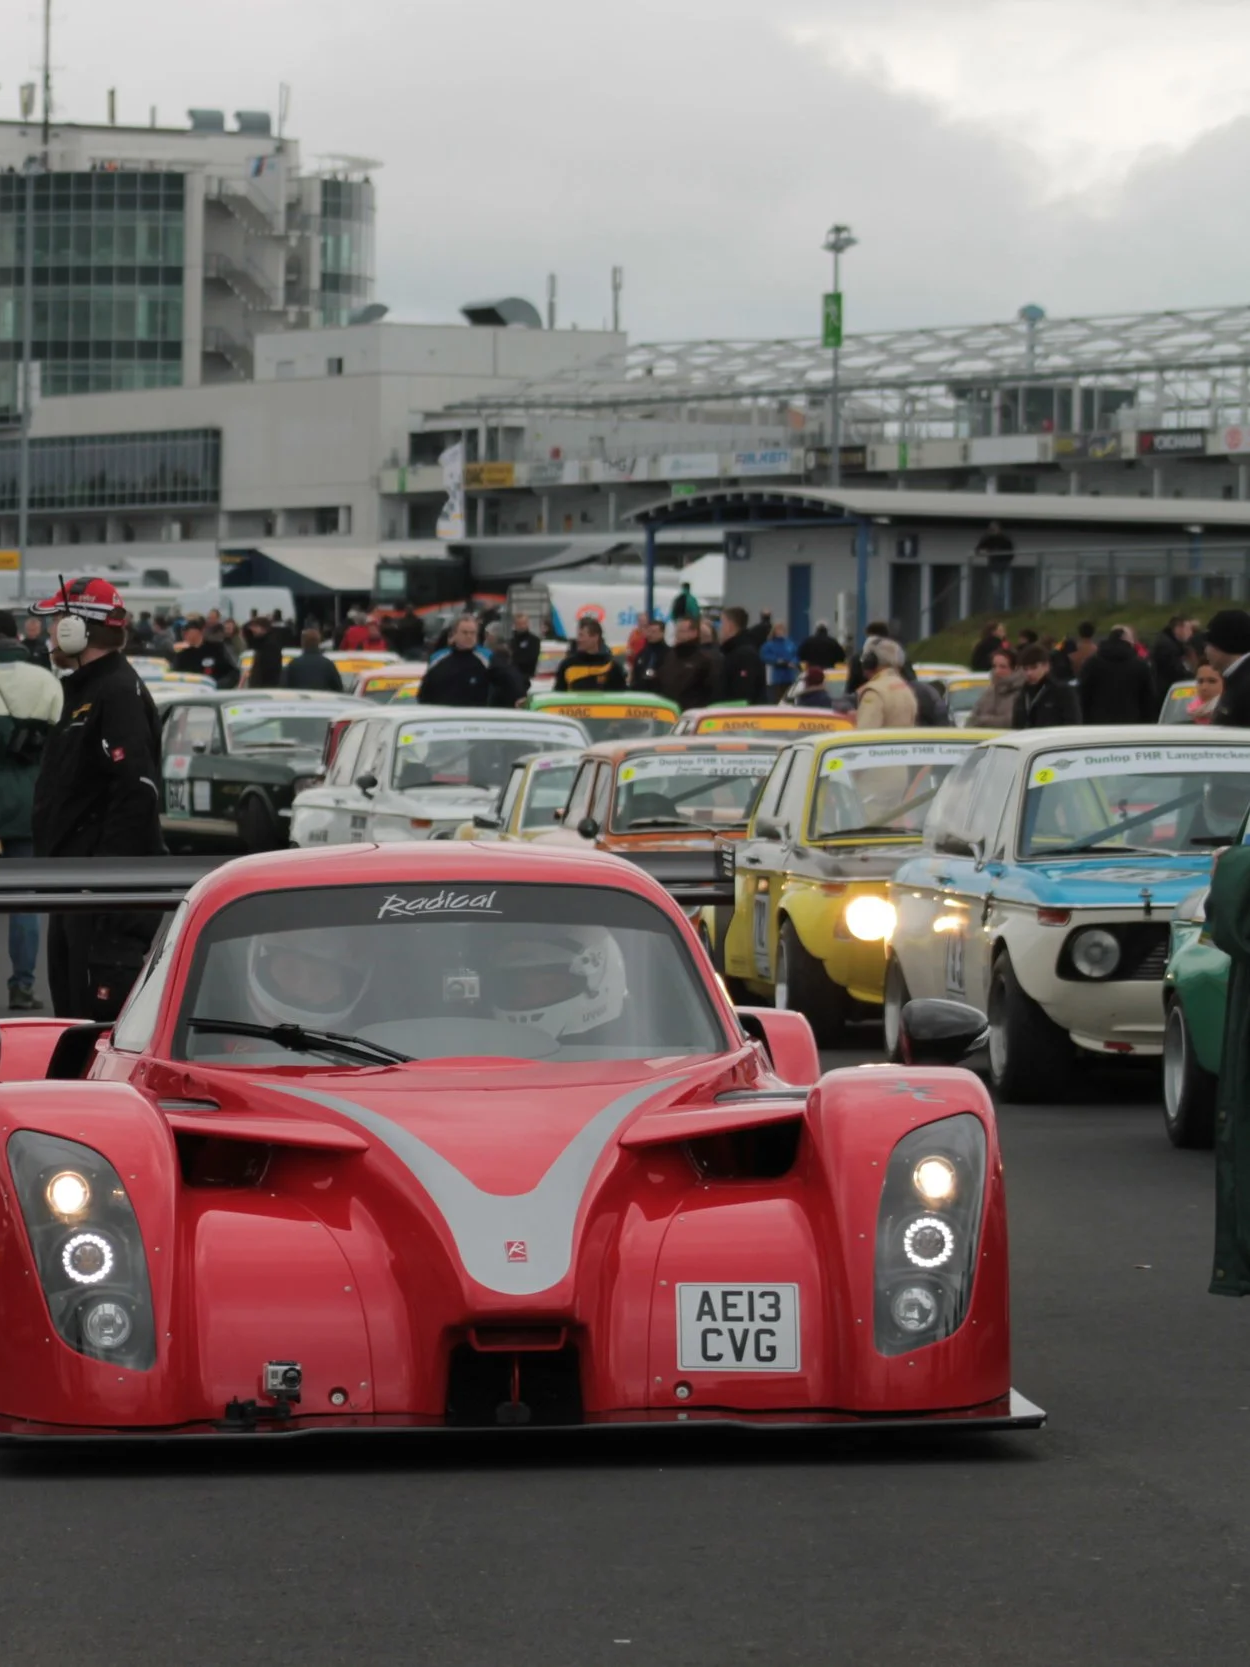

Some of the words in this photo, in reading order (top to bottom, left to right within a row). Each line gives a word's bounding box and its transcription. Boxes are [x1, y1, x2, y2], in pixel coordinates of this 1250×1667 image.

[558, 707, 591, 718] ADAC
[625, 709, 658, 719] ADAC
[722, 721, 760, 730] ADAC
[798, 721, 835, 731] ADAC
[1085, 754, 1130, 765] Dunlop
[1135, 752, 1162, 761] FHR
[1039, 771, 1048, 781] 2
[377, 889, 502, 919] Radical
[696, 1290, 781, 1323] AE13
[701, 1327, 777, 1363] CVG
